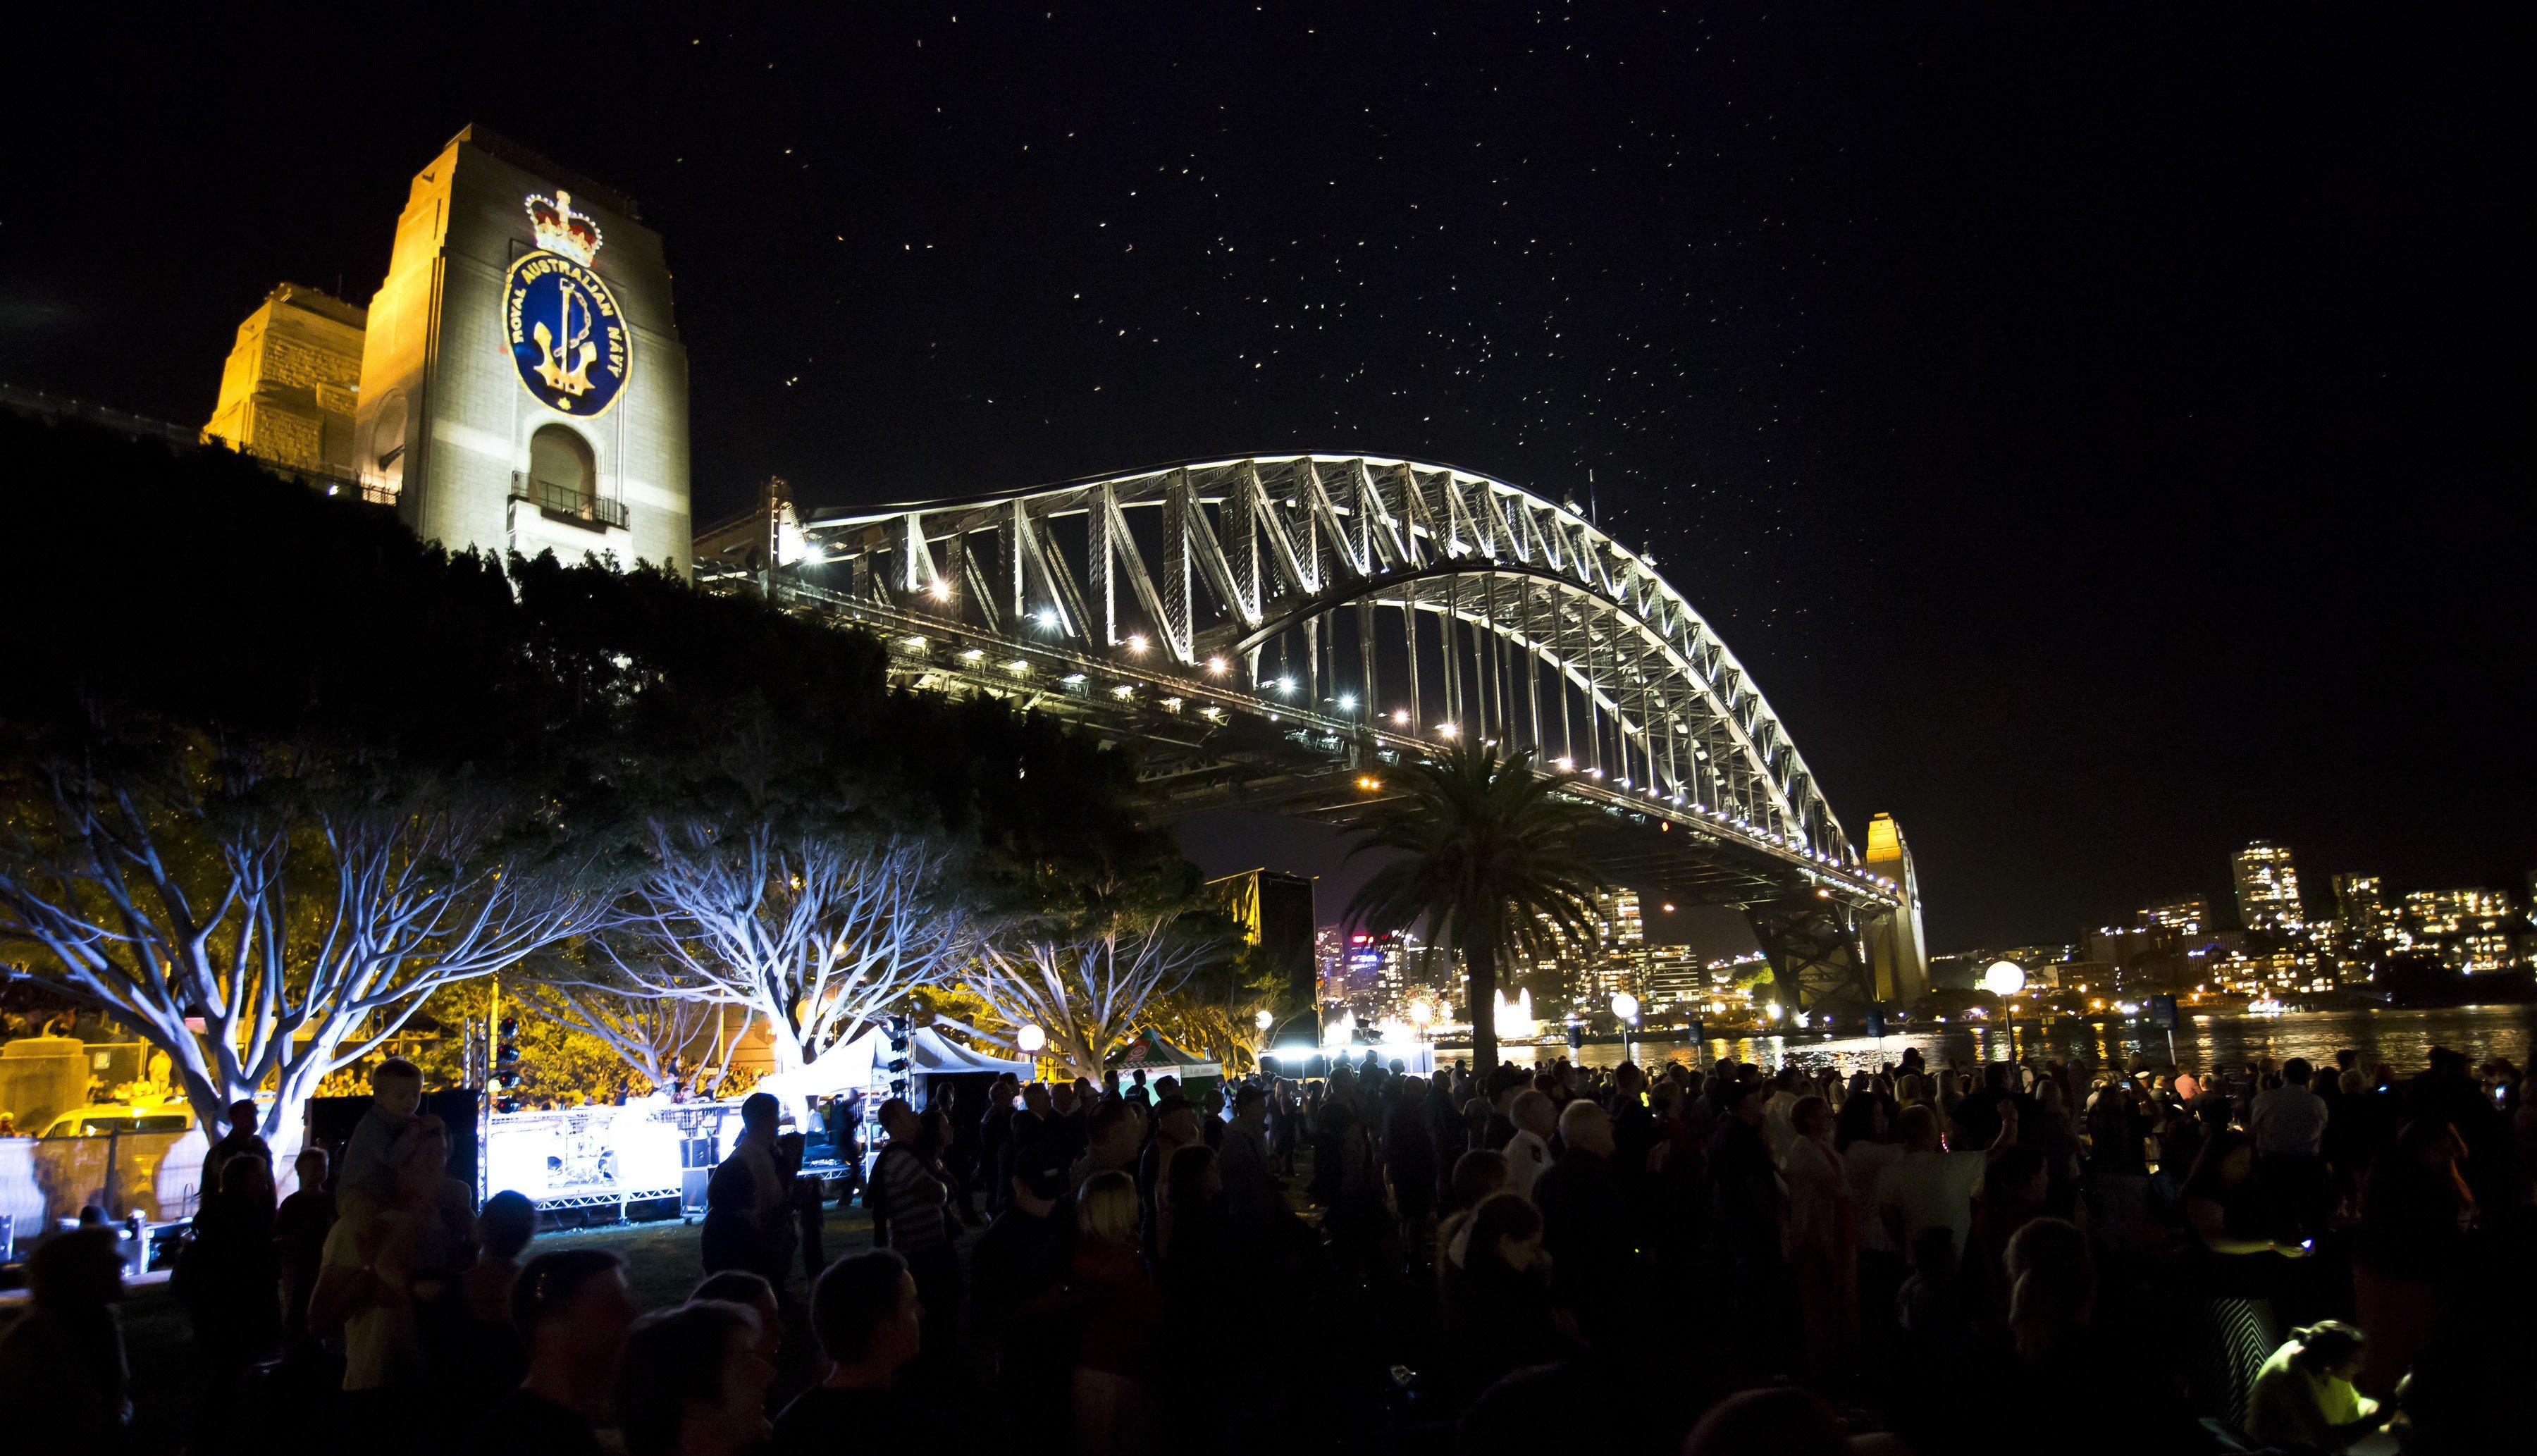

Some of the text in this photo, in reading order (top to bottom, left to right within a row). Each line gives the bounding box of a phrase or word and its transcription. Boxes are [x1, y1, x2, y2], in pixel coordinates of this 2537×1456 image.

[510, 259, 624, 378] ROYAL AUSTRALIAN NAVY
